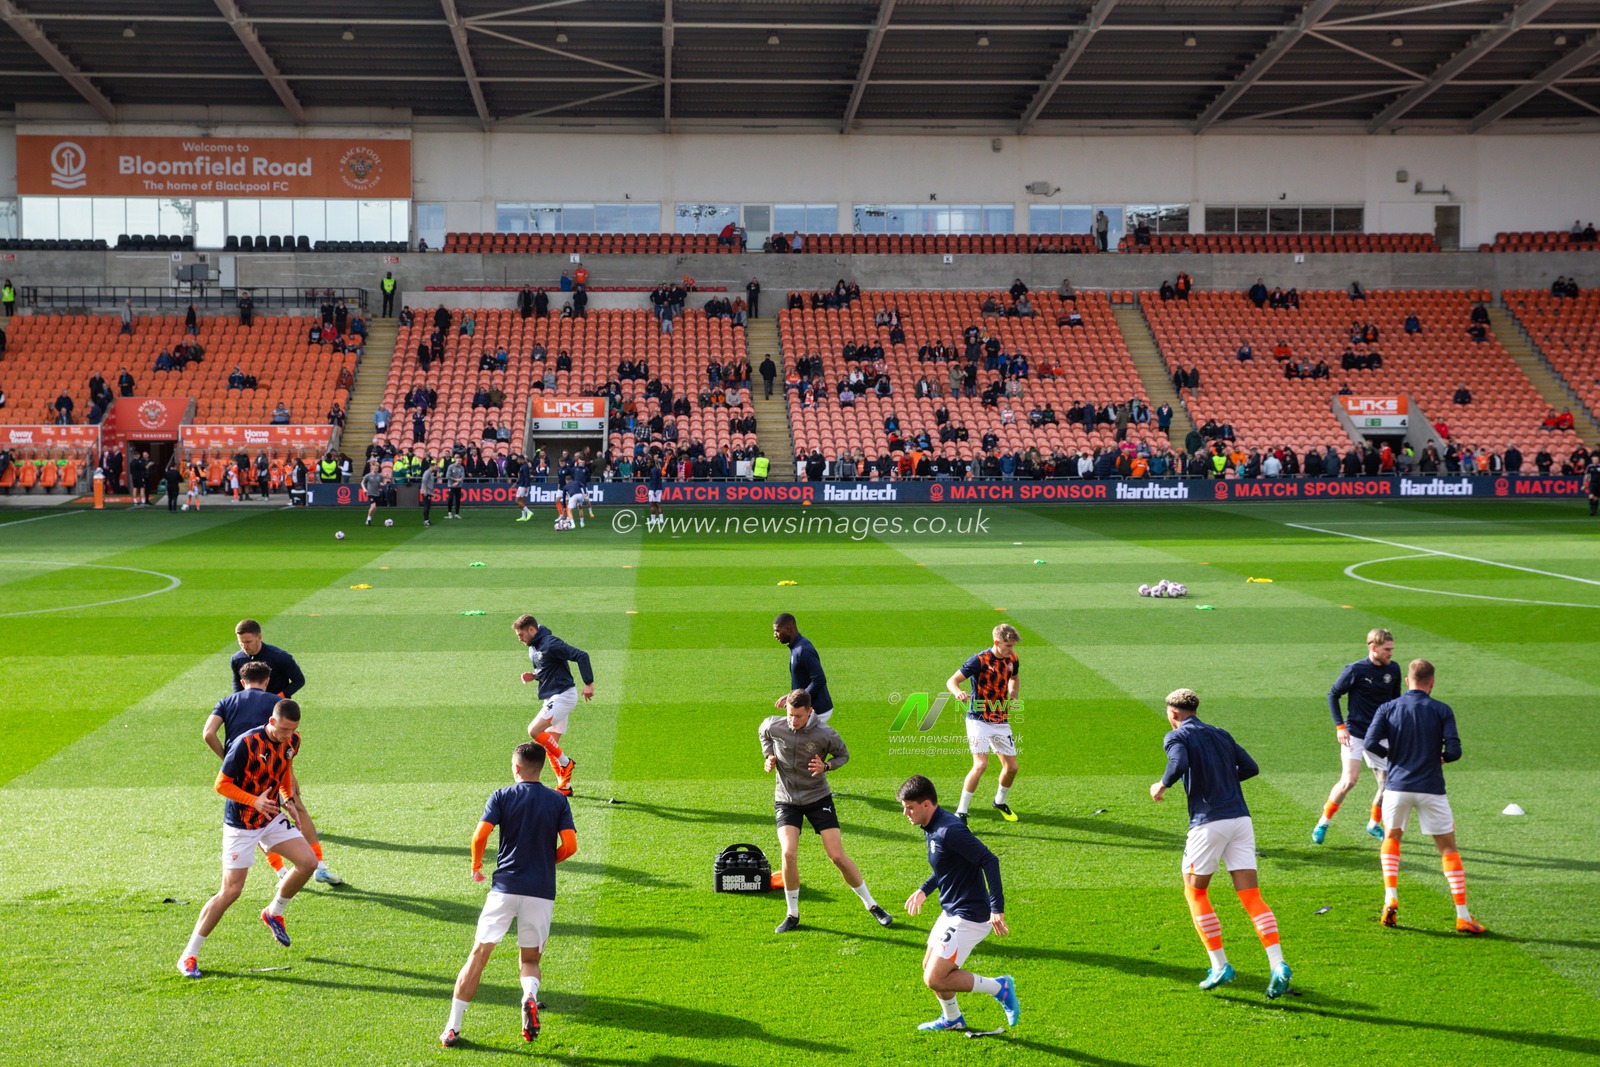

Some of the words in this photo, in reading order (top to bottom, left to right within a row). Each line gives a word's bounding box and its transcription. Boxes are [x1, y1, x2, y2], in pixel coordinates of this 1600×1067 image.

[182, 142, 234, 152] Welcome
[237, 142, 249, 152] to
[340, 147, 381, 165] BLACKPOOL
[118, 155, 246, 176] Bloomfield
[253, 157, 312, 176] Road
[143, 180, 164, 191] The
[166, 180, 198, 191] home
[200, 181, 213, 191] of
[215, 181, 270, 193] Blackpool
[273, 181, 289, 192] FC
[244, 429, 269, 438] Home
[660, 486, 719, 500] MATCH
[726, 486, 814, 500] SPONSOR
[823, 484, 897, 501] Hardtech
[951, 485, 1013, 499] MATCH
[1019, 485, 1106, 499] SPONSOR
[1116, 482, 1189, 499] Hardtech
[1235, 483, 1298, 497] MATCH
[1304, 481, 1391, 496] SPONSOR
[1400, 478, 1473, 496] Hardtech
[1515, 480, 1578, 494] MATCH
[722, 875, 745, 883] SOCCER
[722, 882, 761, 891] SUPPLEMENT
[943, 926, 956, 943] 5
